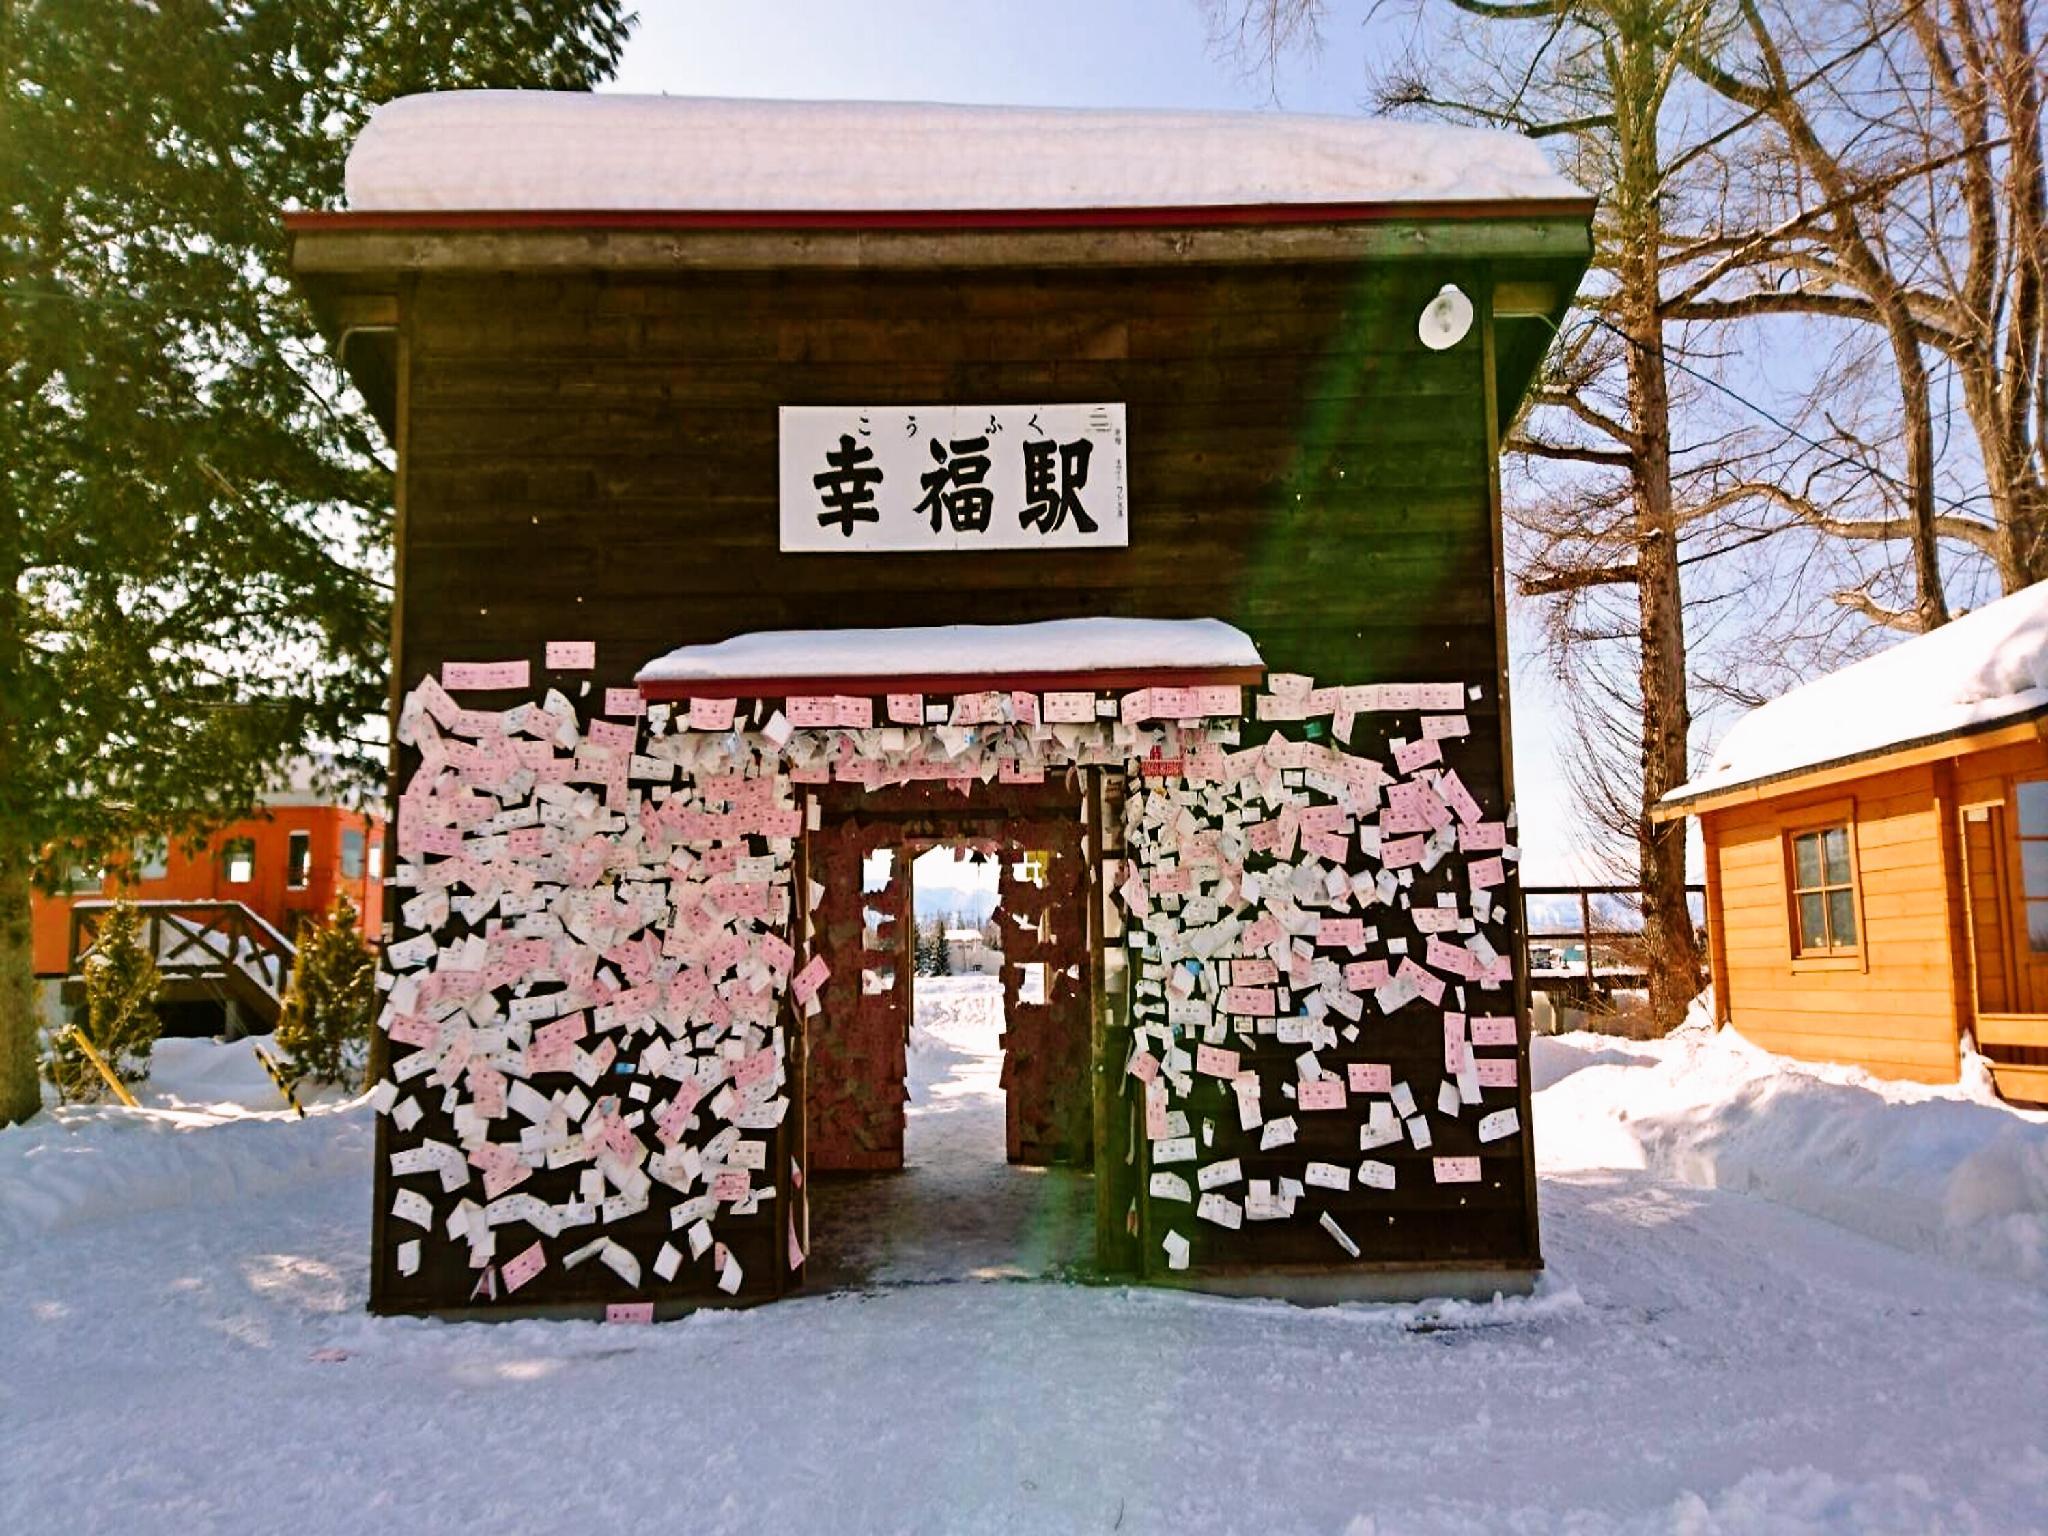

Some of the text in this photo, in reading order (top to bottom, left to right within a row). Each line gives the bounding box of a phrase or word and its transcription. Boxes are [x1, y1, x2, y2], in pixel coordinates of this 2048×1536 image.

[858, 414, 1044, 438] こうふく
[813, 434, 1098, 537] 幸福駅
